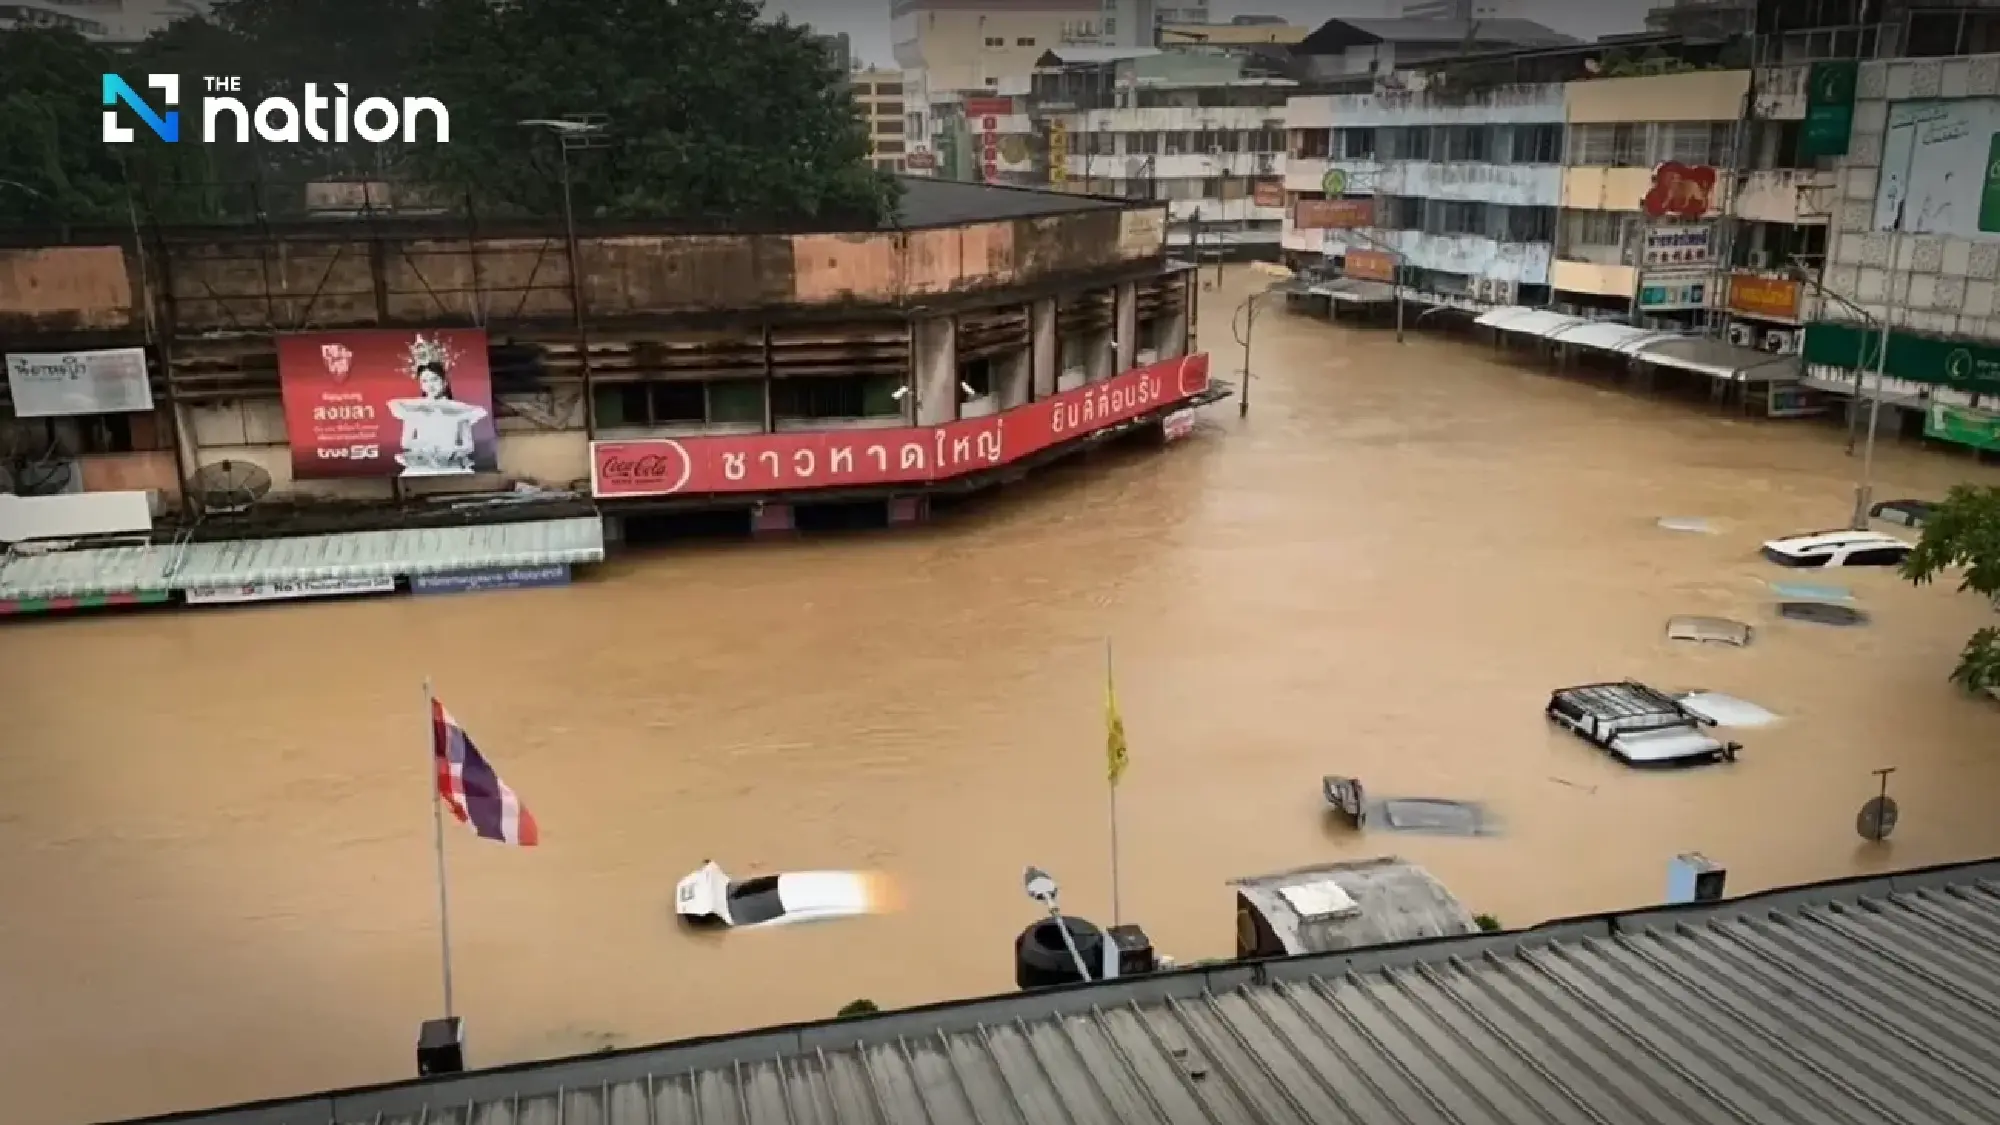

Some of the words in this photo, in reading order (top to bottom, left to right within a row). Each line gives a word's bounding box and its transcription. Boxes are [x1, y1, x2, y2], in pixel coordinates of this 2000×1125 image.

[313, 405, 375, 420] สงขลา
[317, 447, 349, 459] true
[722, 418, 1003, 480] ชาวหาดใหญ่
[602, 454, 668, 480] Coca-Cola
